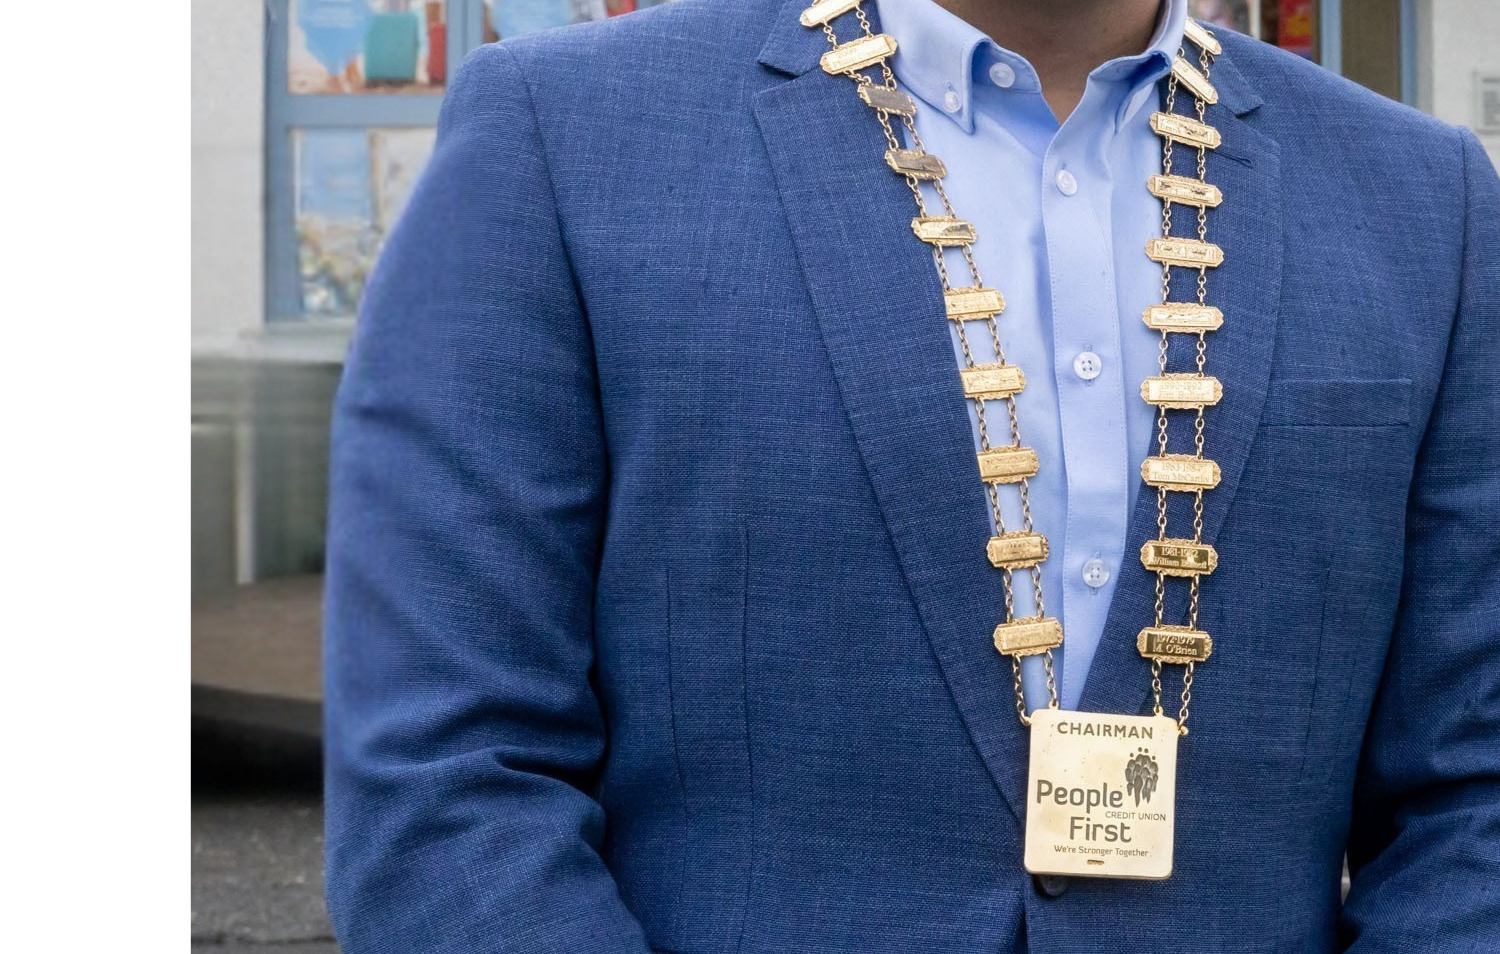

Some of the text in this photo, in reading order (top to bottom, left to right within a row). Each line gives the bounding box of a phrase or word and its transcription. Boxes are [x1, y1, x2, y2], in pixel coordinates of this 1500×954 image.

[1165, 643, 1198, 656] O'Brien
[1057, 722, 1153, 739] CHAIRMAN
[1036, 779, 1123, 814] People
[1105, 810, 1167, 822] CREDIT UNION
[1069, 816, 1132, 843] First
[1054, 845, 1149, 858] We're Stronger Together
